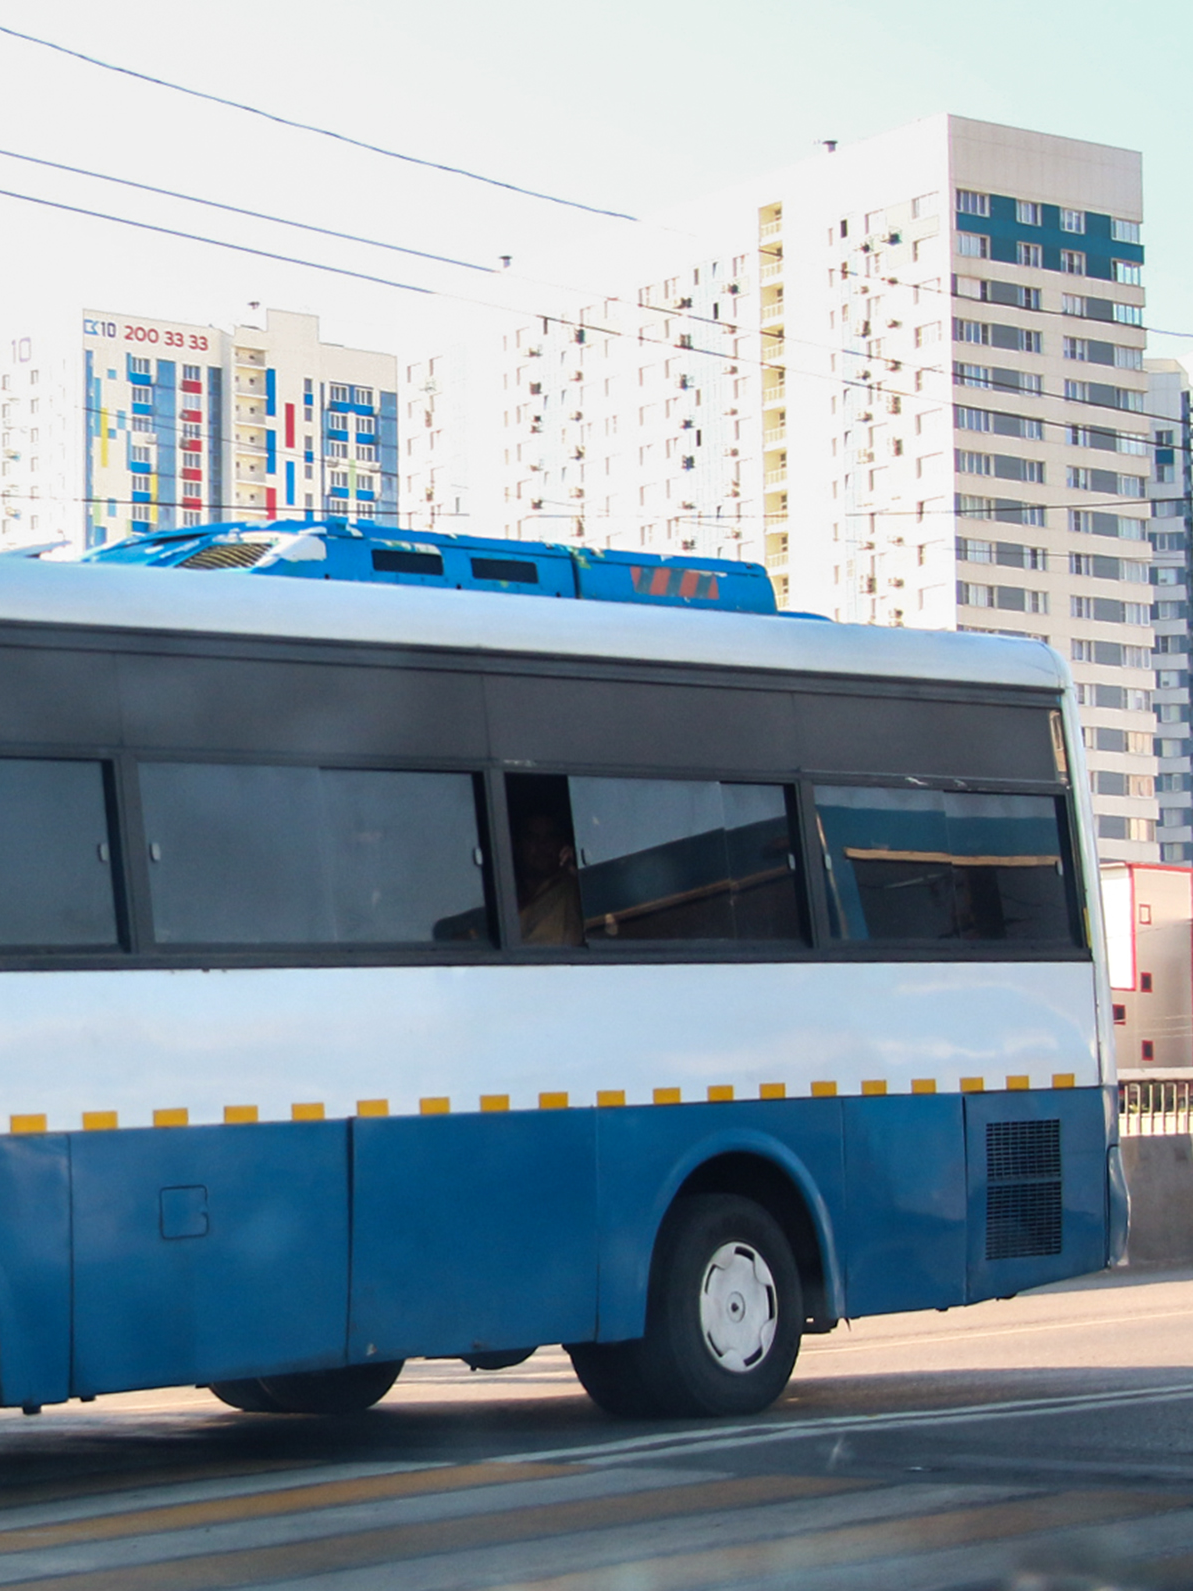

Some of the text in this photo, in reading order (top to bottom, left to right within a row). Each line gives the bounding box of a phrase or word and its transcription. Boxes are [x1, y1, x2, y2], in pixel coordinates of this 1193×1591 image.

[124, 325, 159, 344] 200
[164, 331, 184, 347] 33
[188, 334, 209, 351] 33
